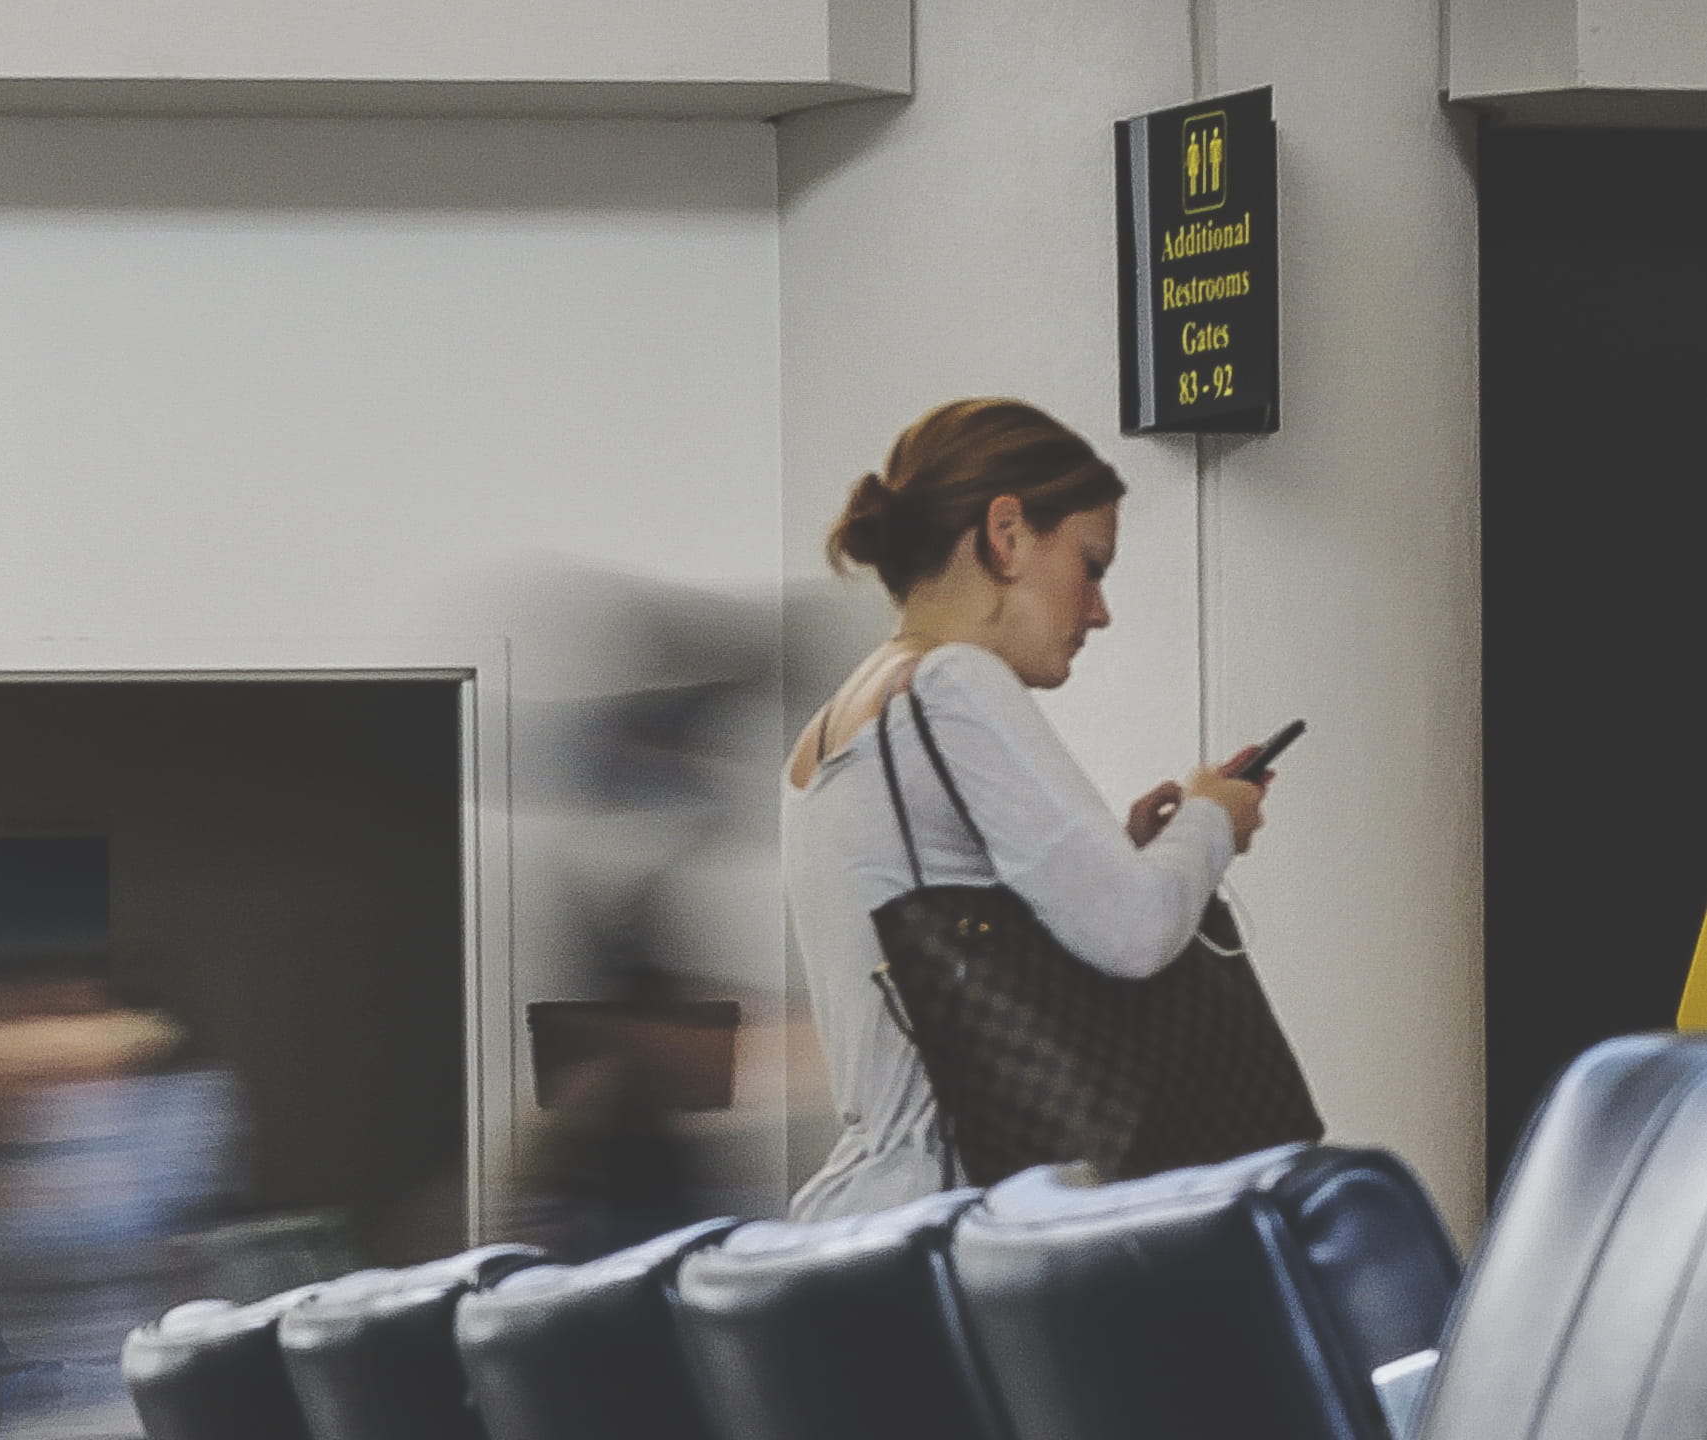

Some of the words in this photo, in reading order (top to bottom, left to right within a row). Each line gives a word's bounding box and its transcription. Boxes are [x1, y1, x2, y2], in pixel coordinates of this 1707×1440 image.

[1161, 211, 1250, 262] Additional
[1162, 269, 1251, 311] Restrooms
[1181, 321, 1229, 355] Gates
[1178, 370, 1198, 406] 83
[1213, 363, 1233, 399] 92
